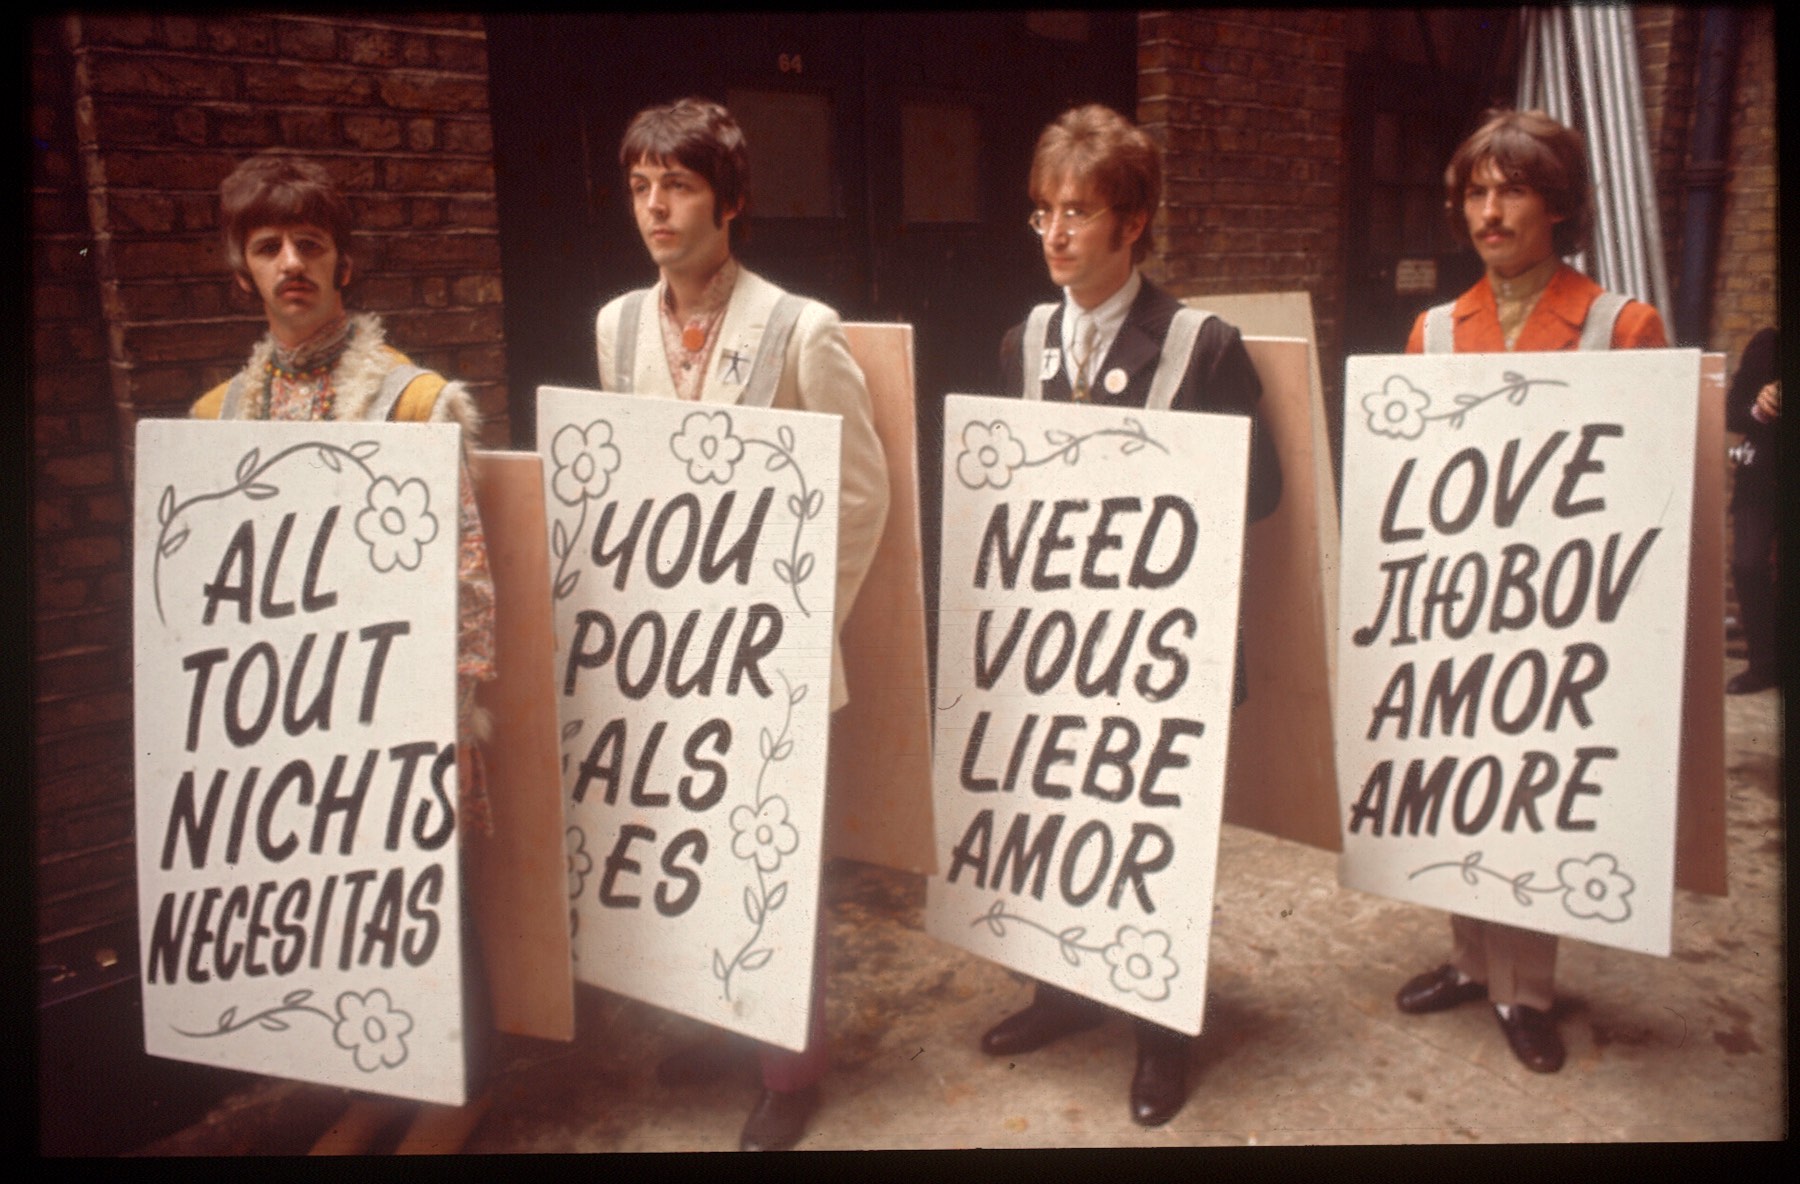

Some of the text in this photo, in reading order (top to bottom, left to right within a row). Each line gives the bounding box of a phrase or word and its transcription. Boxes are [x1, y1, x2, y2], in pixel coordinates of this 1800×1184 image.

[1381, 424, 1624, 543] LOVE
[202, 506, 341, 625] ALL
[591, 487, 774, 591] YOU
[974, 495, 1199, 591] NEED
[183, 622, 410, 752] TOUT
[563, 602, 783, 700] POUR
[974, 607, 1197, 703] VOUS
[1366, 642, 1610, 741] AMOR
[160, 742, 456, 870] NICHTS
[572, 718, 732, 812] ALS
[959, 711, 1205, 808] LIEBE
[1349, 747, 1619, 838] AMORE
[598, 824, 709, 917] ES
[946, 809, 1174, 914] AMOR
[147, 864, 443, 985] NECESITAS
